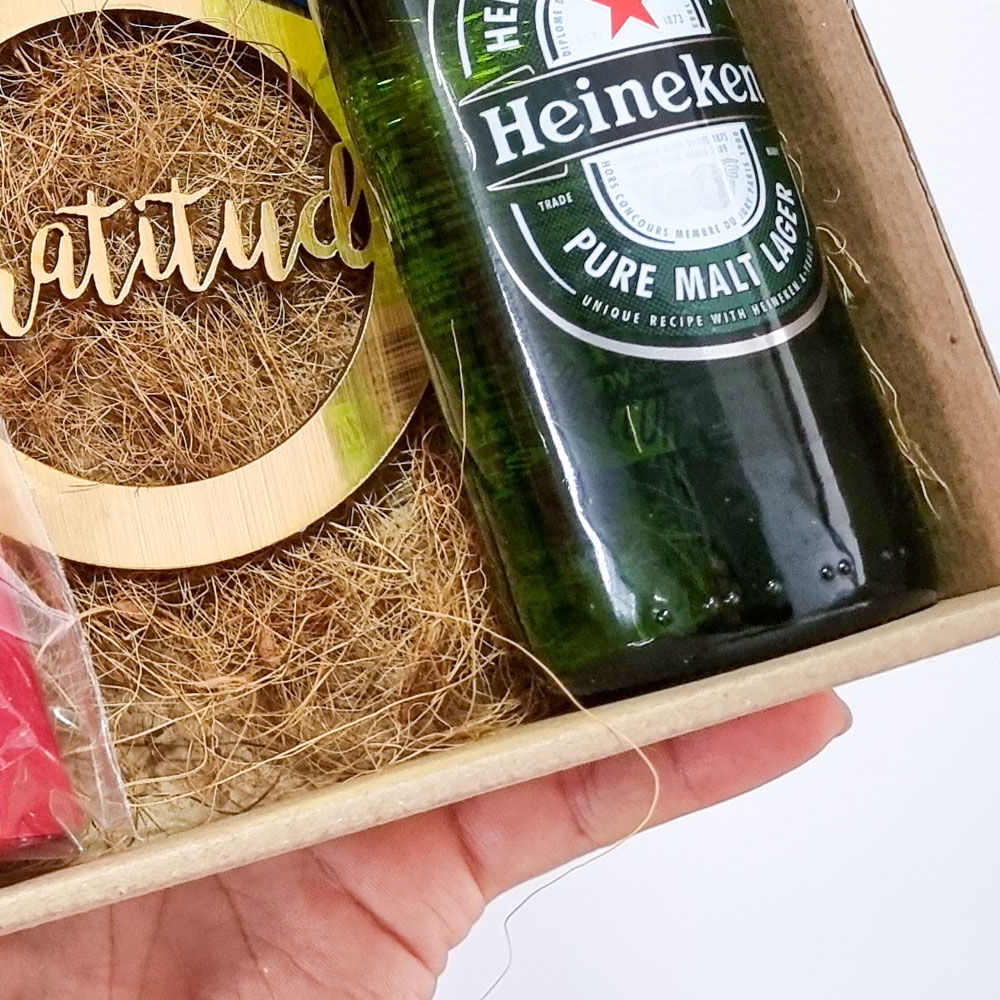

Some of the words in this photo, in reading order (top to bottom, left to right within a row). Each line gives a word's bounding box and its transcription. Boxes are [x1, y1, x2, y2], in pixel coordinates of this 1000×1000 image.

[553, 9, 572, 57] DIPLOME
[479, 53, 766, 167] Heineken
[537, 192, 574, 213] TRADE
[601, 159, 620, 189] HORS
[615, 193, 669, 237] CONCOURS
[675, 224, 721, 239] MEMBRE
[723, 216, 738, 230] DU
[562, 227, 657, 299] PURE
[674, 251, 762, 301] MALT
[759, 182, 798, 273] LAGER
[582, 294, 640, 324] UNIQUE
[649, 314, 704, 328] RECIPE
[710, 308, 748, 326] WITH
[751, 280, 801, 316] HEINEKEN
